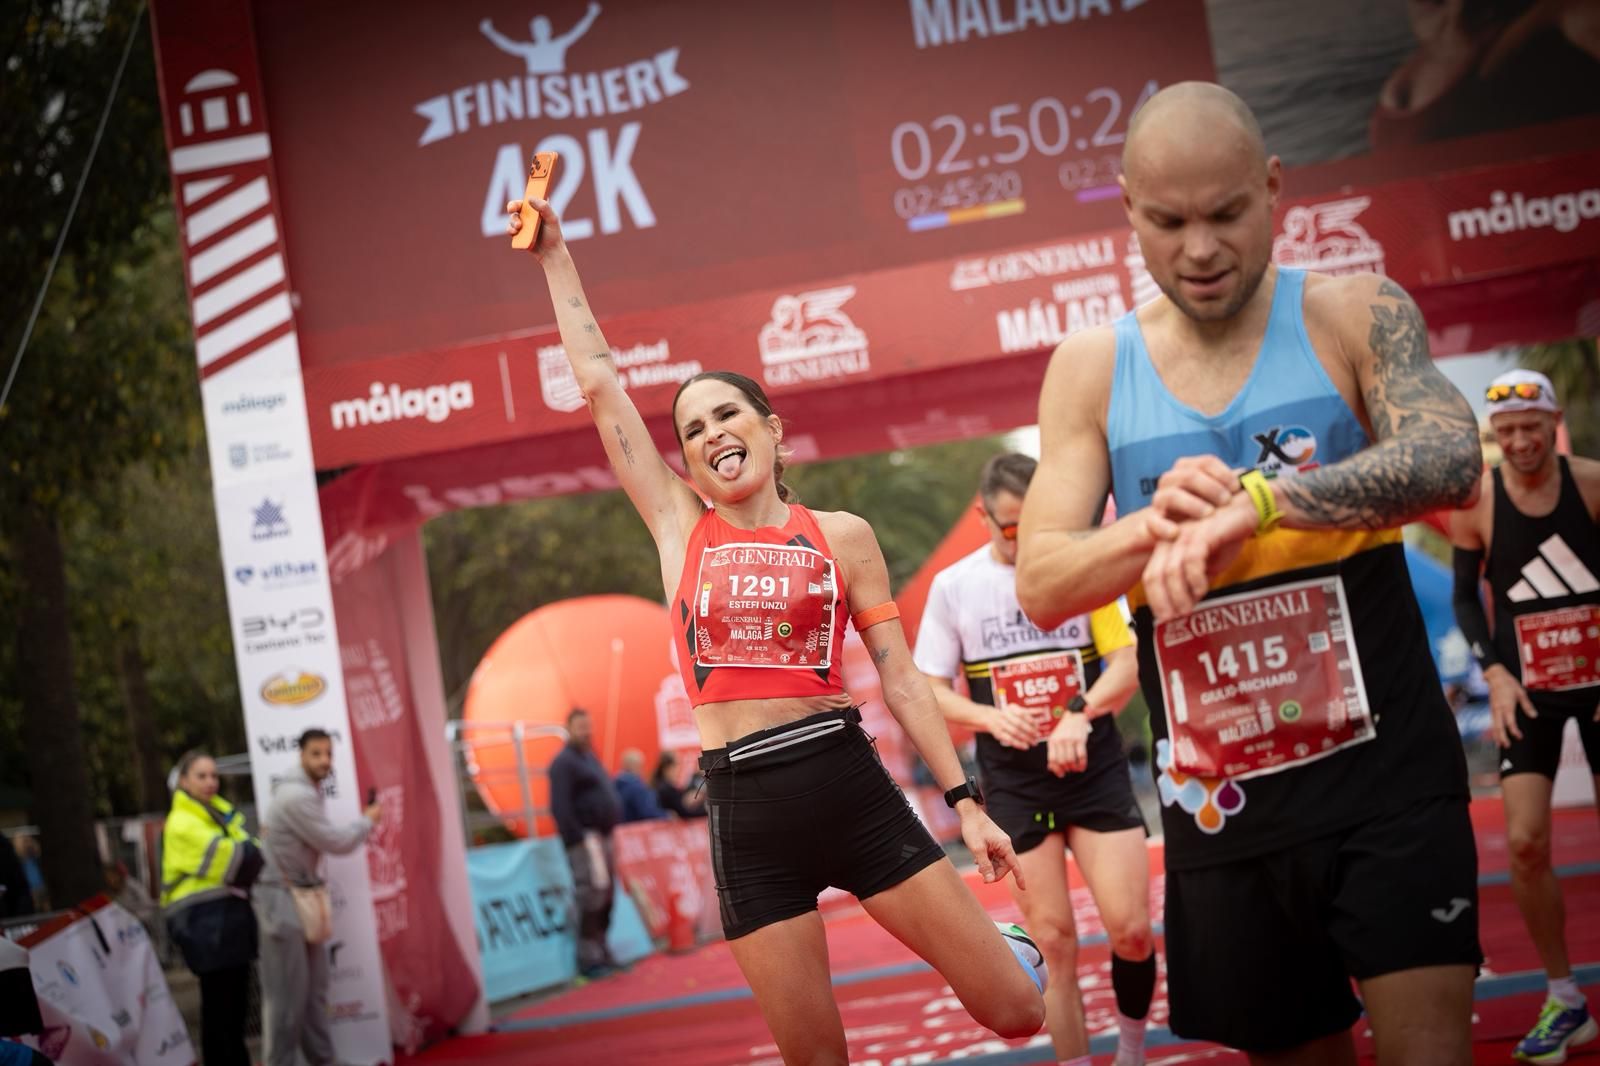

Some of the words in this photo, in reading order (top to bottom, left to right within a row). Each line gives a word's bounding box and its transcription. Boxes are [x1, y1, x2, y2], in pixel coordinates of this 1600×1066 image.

[453, 60, 663, 133] FINISHER
[481, 122, 657, 240] 42K
[987, 237, 1115, 284] GENERALI
[997, 294, 1127, 354] MÁLAGA
[609, 338, 670, 368] iudad
[732, 549, 816, 570] GENERALI
[729, 574, 790, 598] 1291
[729, 599, 759, 609] ESTEFI
[761, 599, 787, 610] UNZU
[1190, 591, 1312, 637] GENERALI
[730, 616, 763, 624] GENERALI
[819, 631, 829, 647] BOX
[1536, 627, 1583, 649] 6746
[1197, 634, 1289, 685] 1415
[1013, 675, 1060, 699] 1656
[1200, 670, 1298, 706] GIULIO-RICHARD
